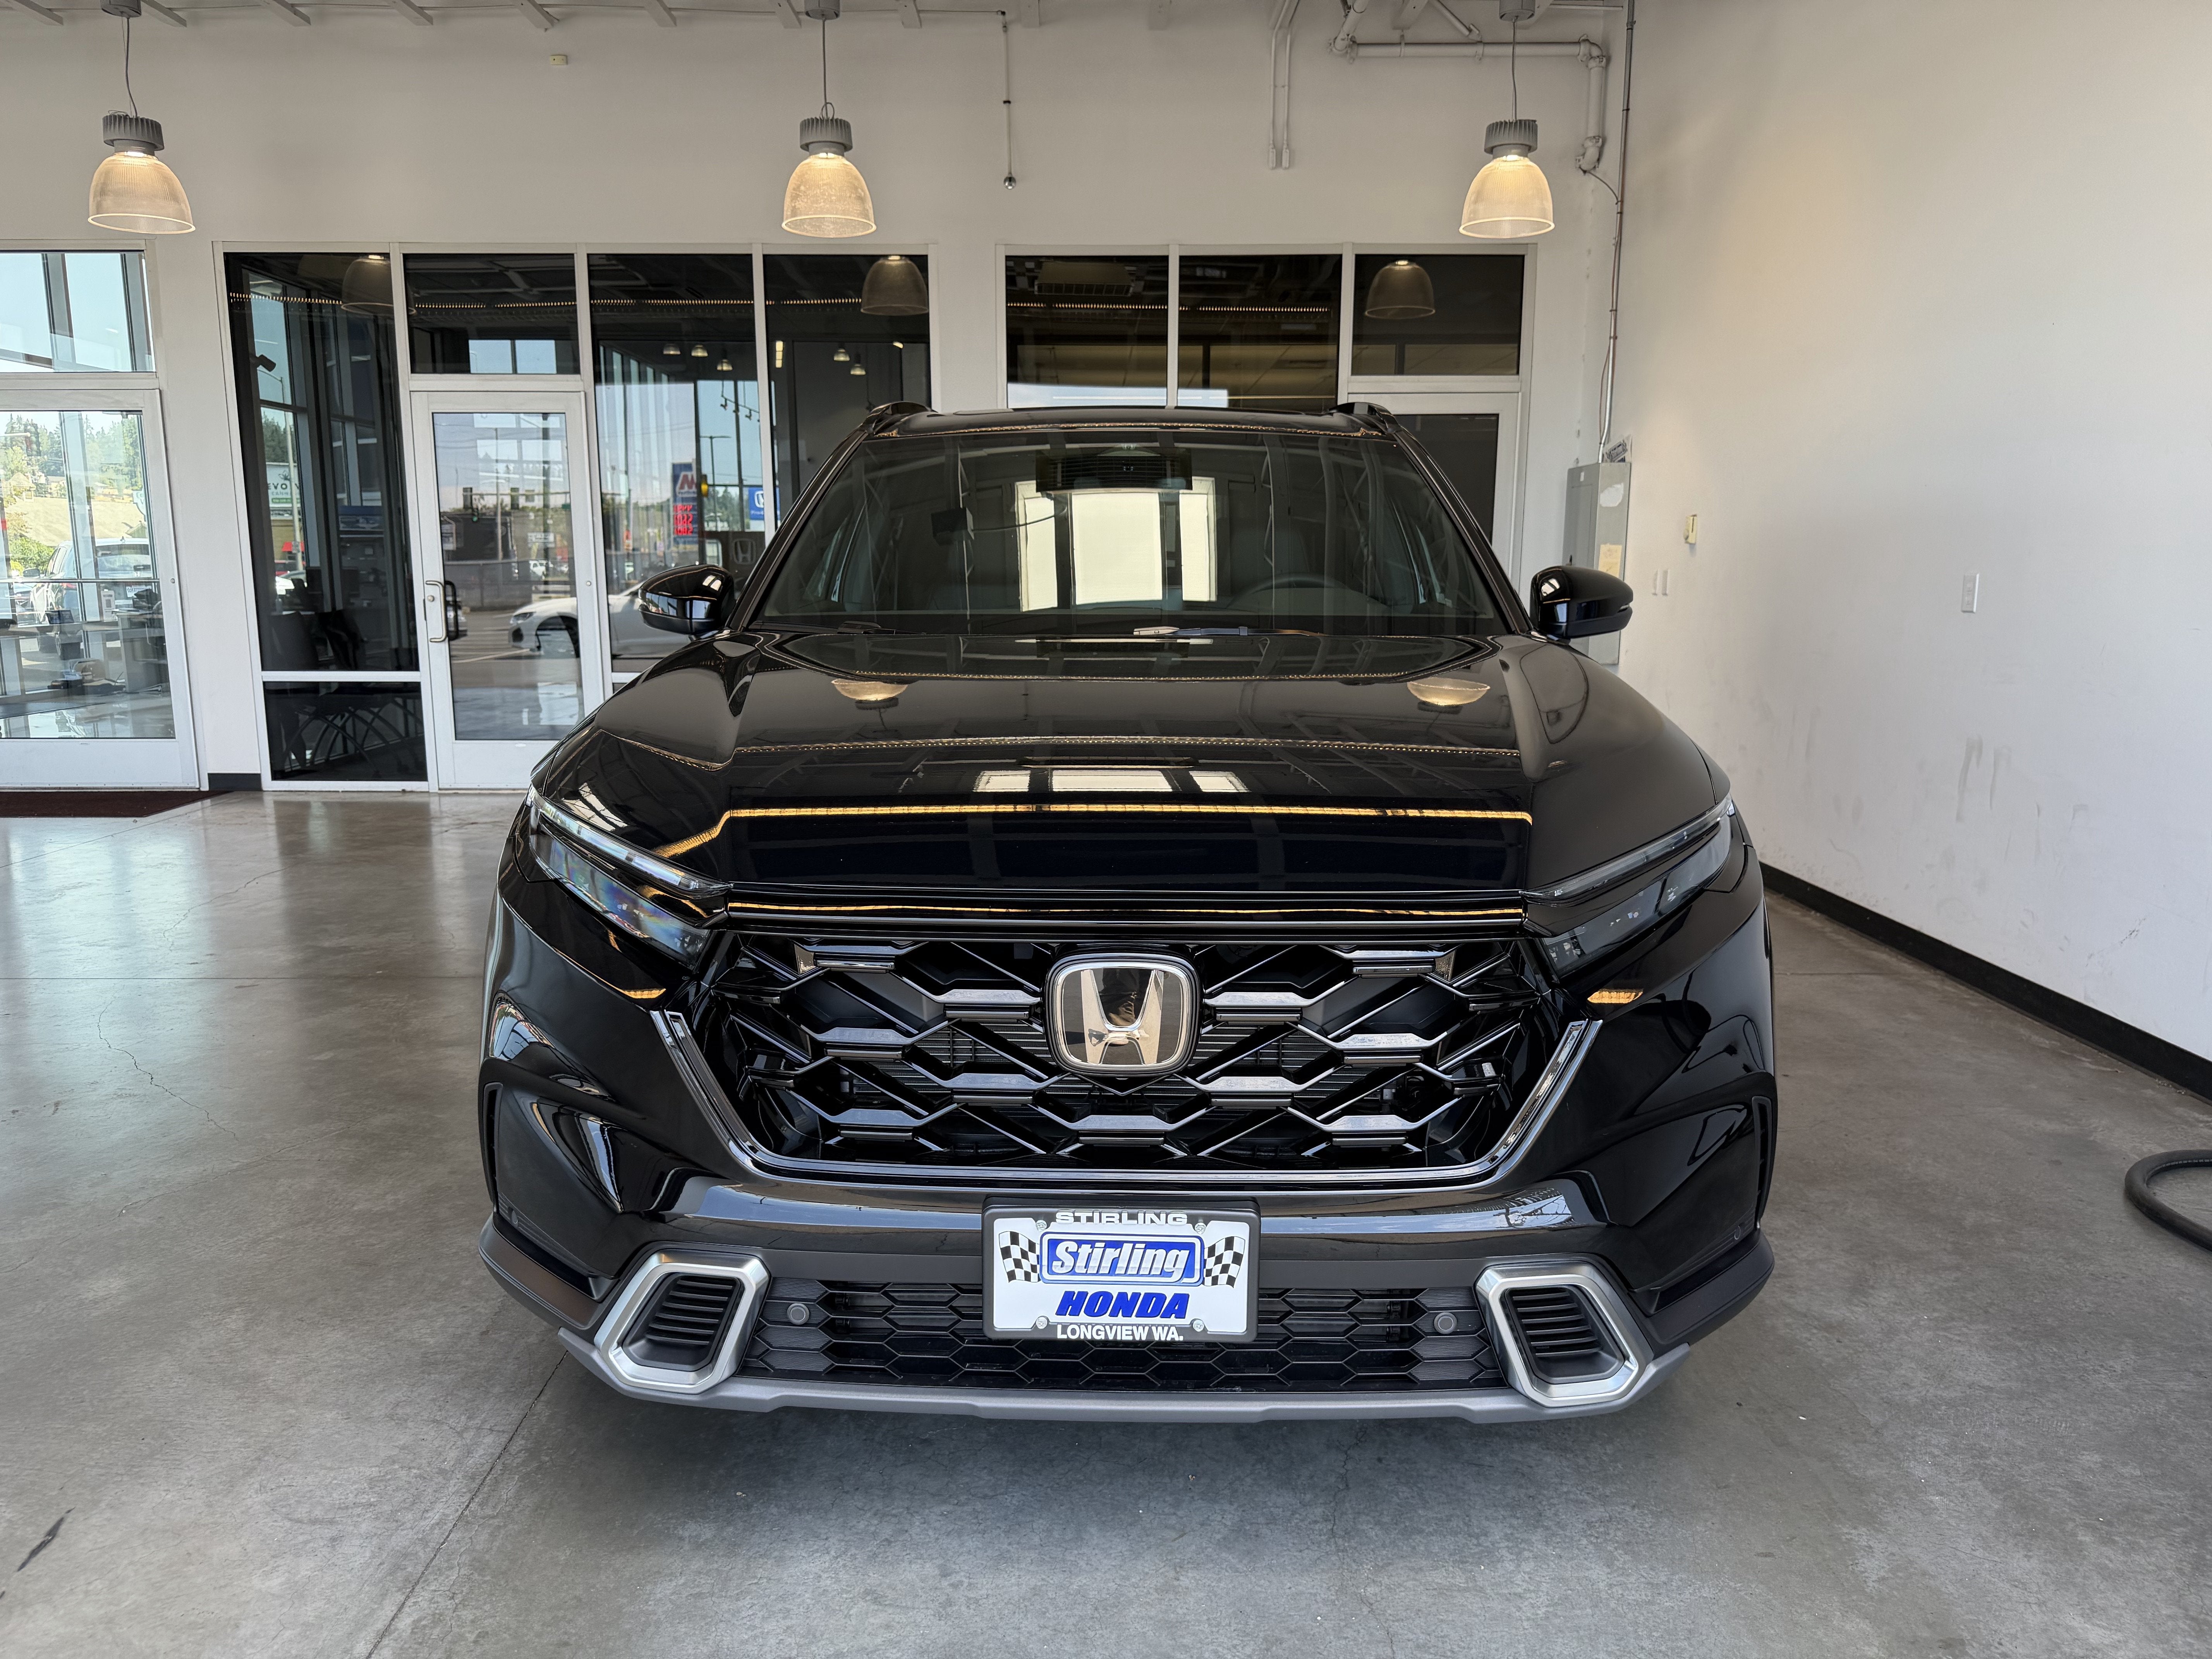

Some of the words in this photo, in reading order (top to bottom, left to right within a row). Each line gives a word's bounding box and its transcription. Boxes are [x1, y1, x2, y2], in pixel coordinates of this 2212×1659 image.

[1056, 1211, 1187, 1225] STIRLING
[1052, 1241, 1190, 1282] Stirling
[1055, 1290, 1190, 1319] HONDA
[1057, 1324, 1149, 1341] LONGVIEW
[1151, 1326, 1184, 1341] WA.
